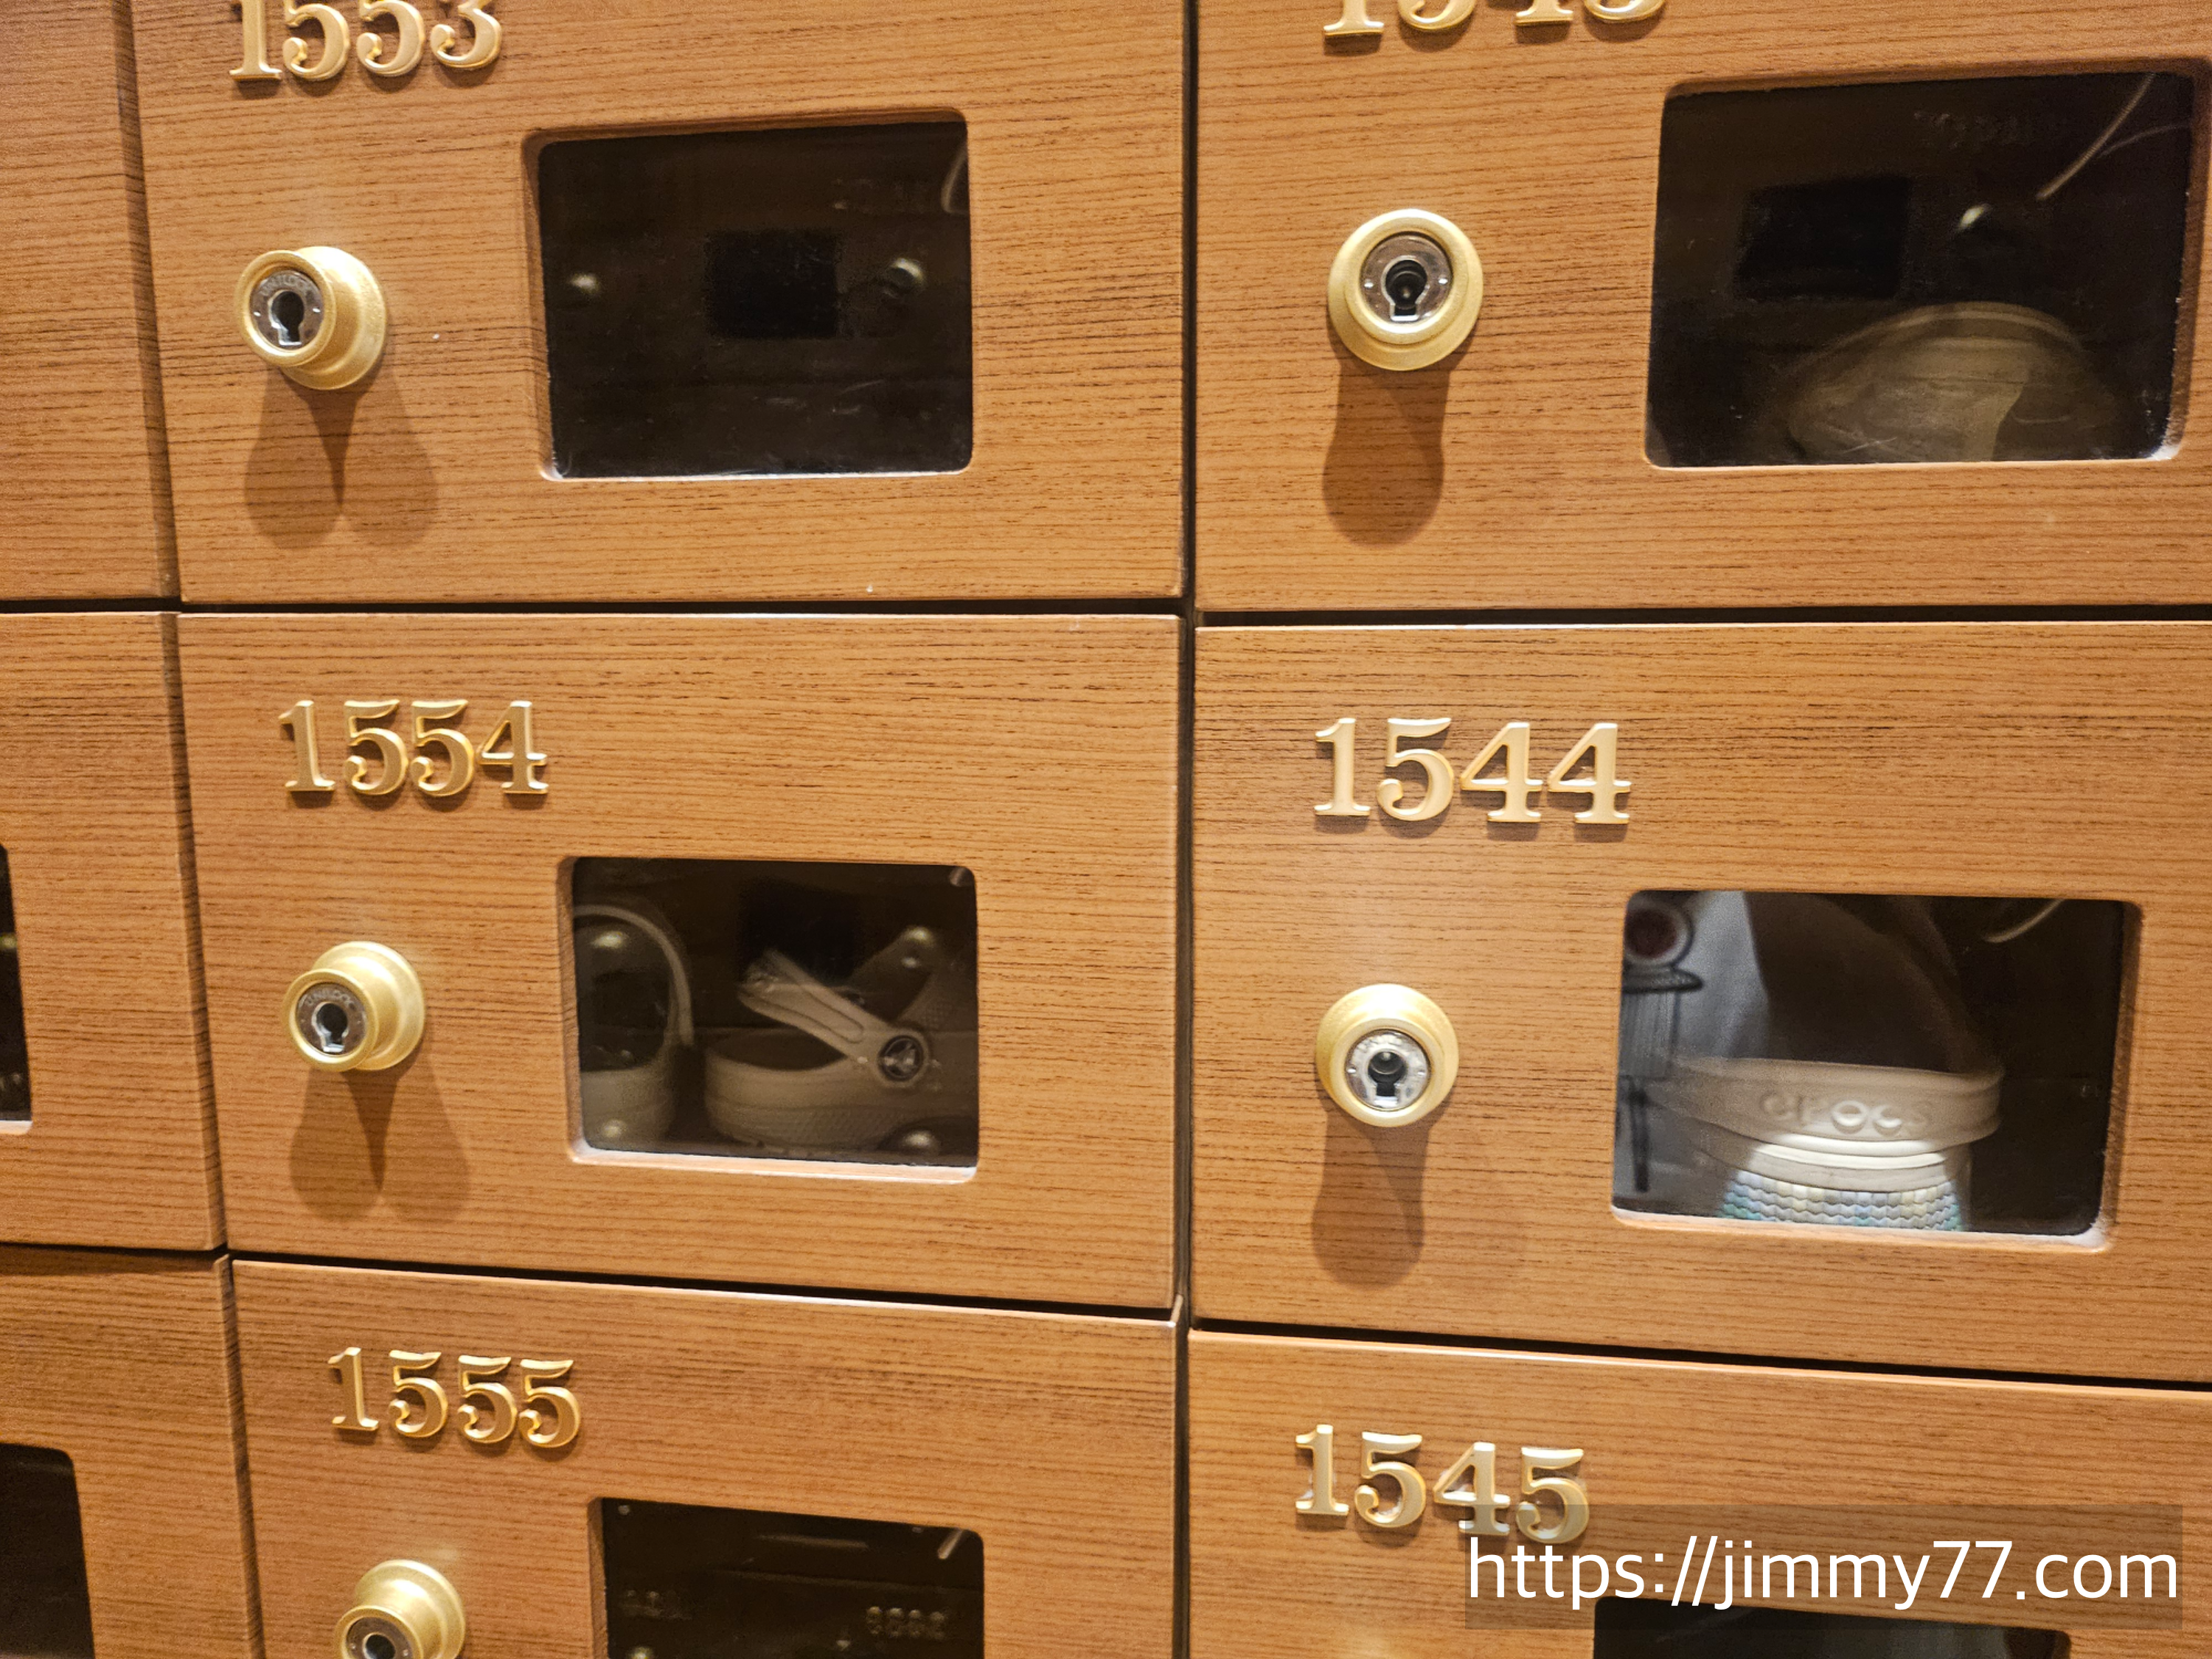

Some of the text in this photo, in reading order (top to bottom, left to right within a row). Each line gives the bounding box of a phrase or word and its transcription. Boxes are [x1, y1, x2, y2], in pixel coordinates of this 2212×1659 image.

[229, 0, 503, 81] 1553
[278, 699, 549, 797] 1554
[1314, 717, 1632, 824] 1544
[1759, 1092, 1930, 1134] crocs
[327, 1346, 580, 1448] 1555
[1295, 1424, 1590, 1544] 1545
